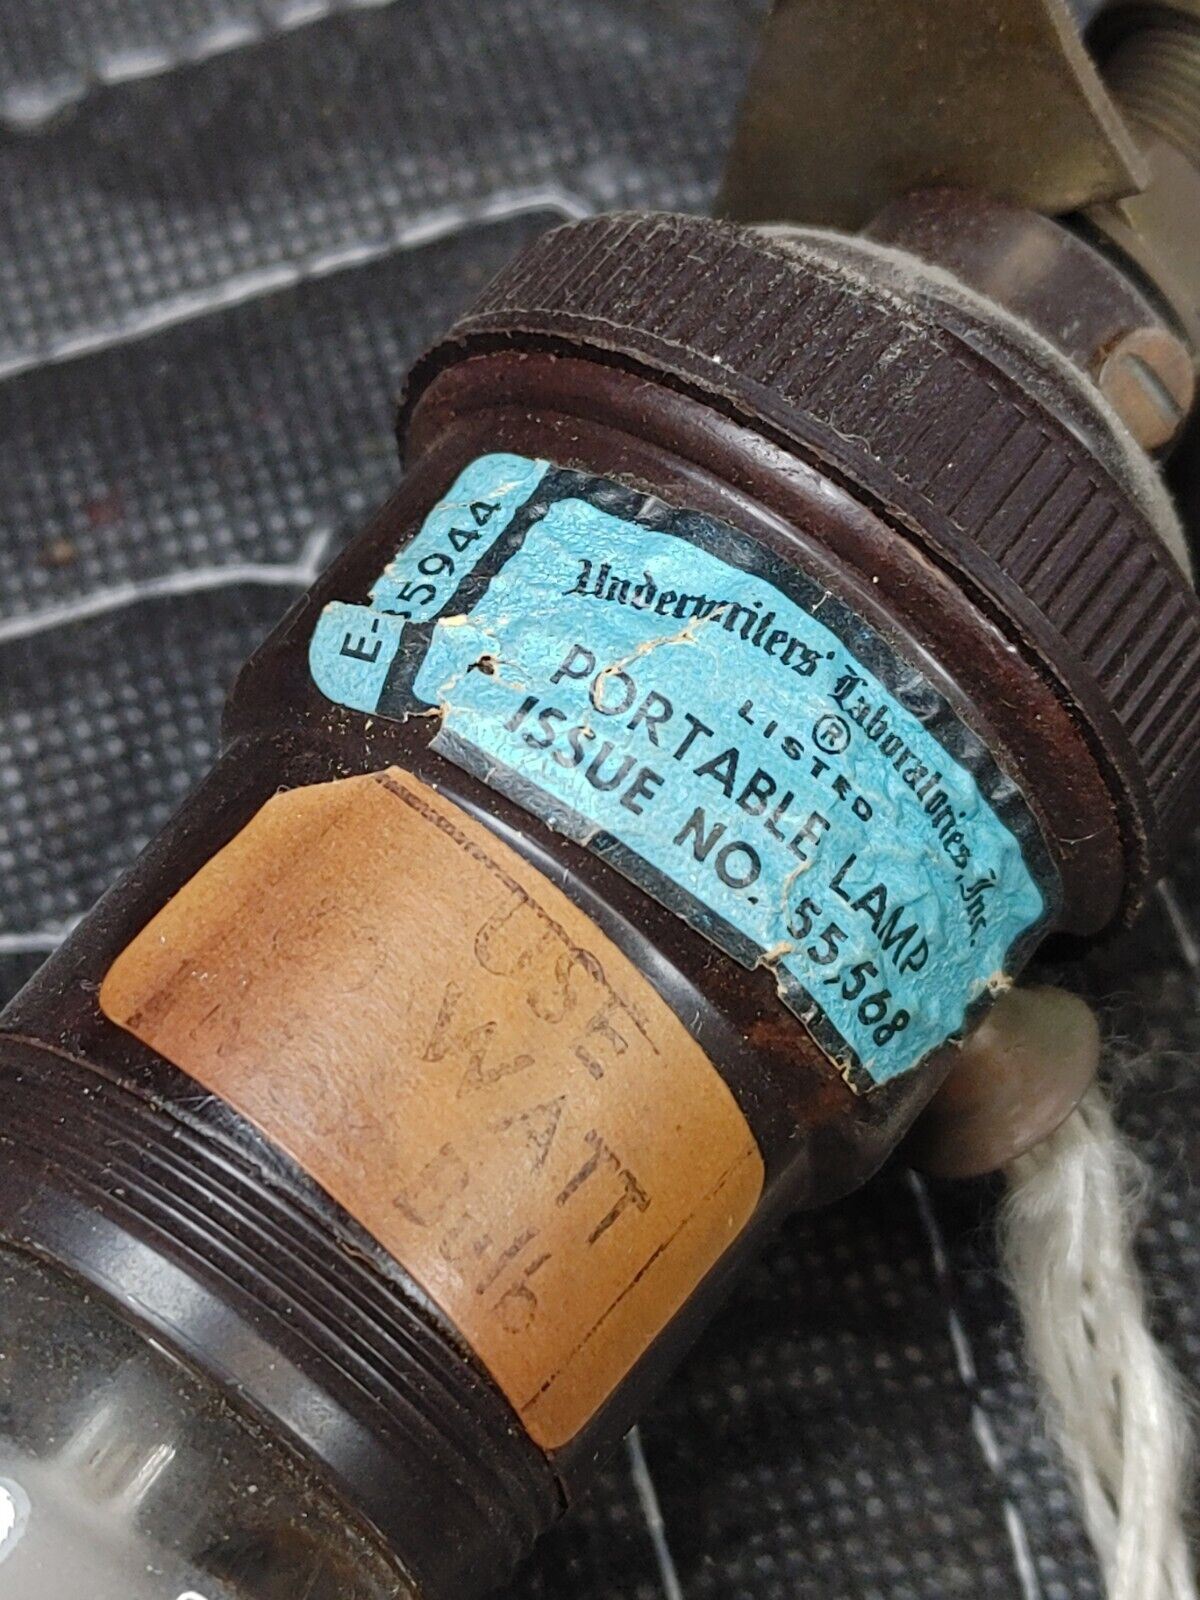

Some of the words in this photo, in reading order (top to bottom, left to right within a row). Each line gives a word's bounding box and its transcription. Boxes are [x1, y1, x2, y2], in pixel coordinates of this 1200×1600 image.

[504, 696, 666, 817] ISSUE
[673, 806, 761, 905] NO.
[788, 896, 912, 1047] 55,568
[550, 643, 831, 862] PORTABLE
[829, 853, 929, 976] LAMP
[738, 699, 873, 823] LISTED
[422, 979, 652, 1244] WATT
[472, 888, 648, 1081] USE
